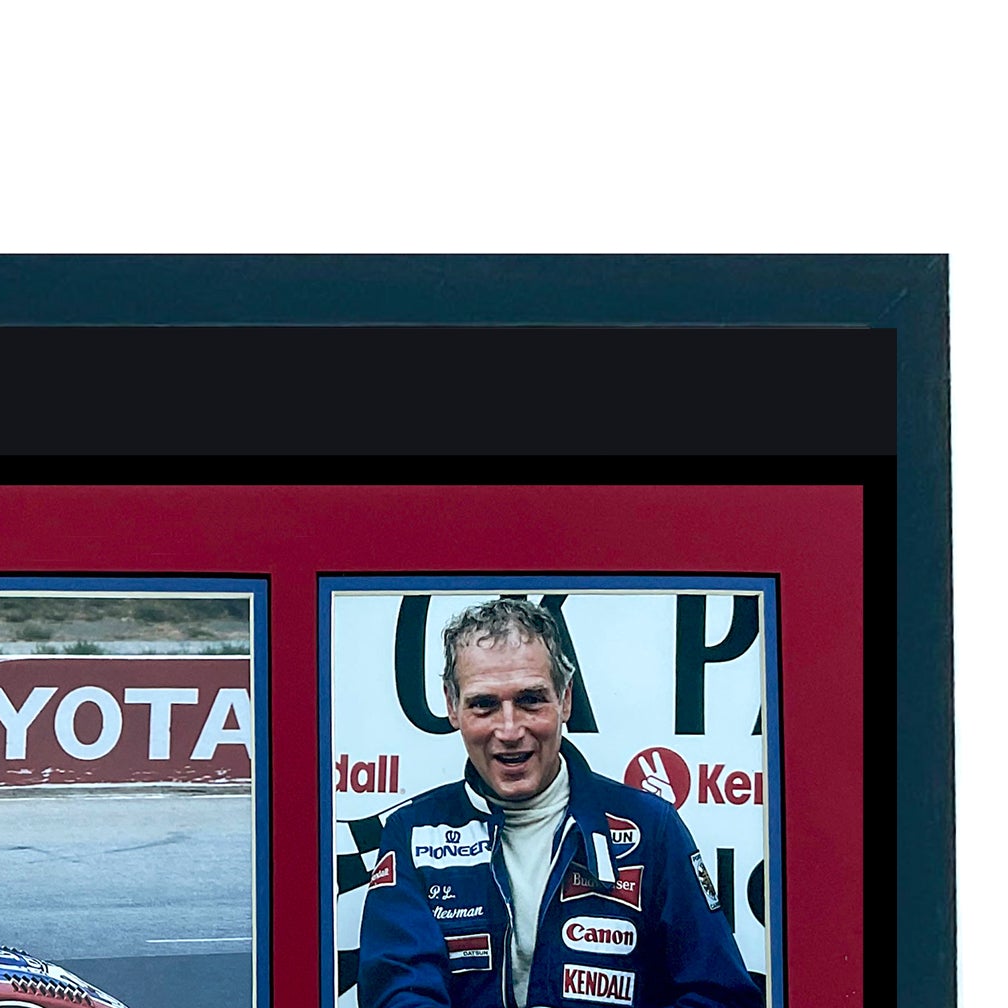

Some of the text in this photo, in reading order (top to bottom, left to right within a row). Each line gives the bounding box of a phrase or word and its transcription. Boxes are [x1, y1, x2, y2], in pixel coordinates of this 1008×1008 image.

[415, 840, 492, 859] PIONEER
[432, 905, 484, 920] Newman
[566, 923, 634, 946] Canon
[564, 968, 632, 1002] KENDALL
